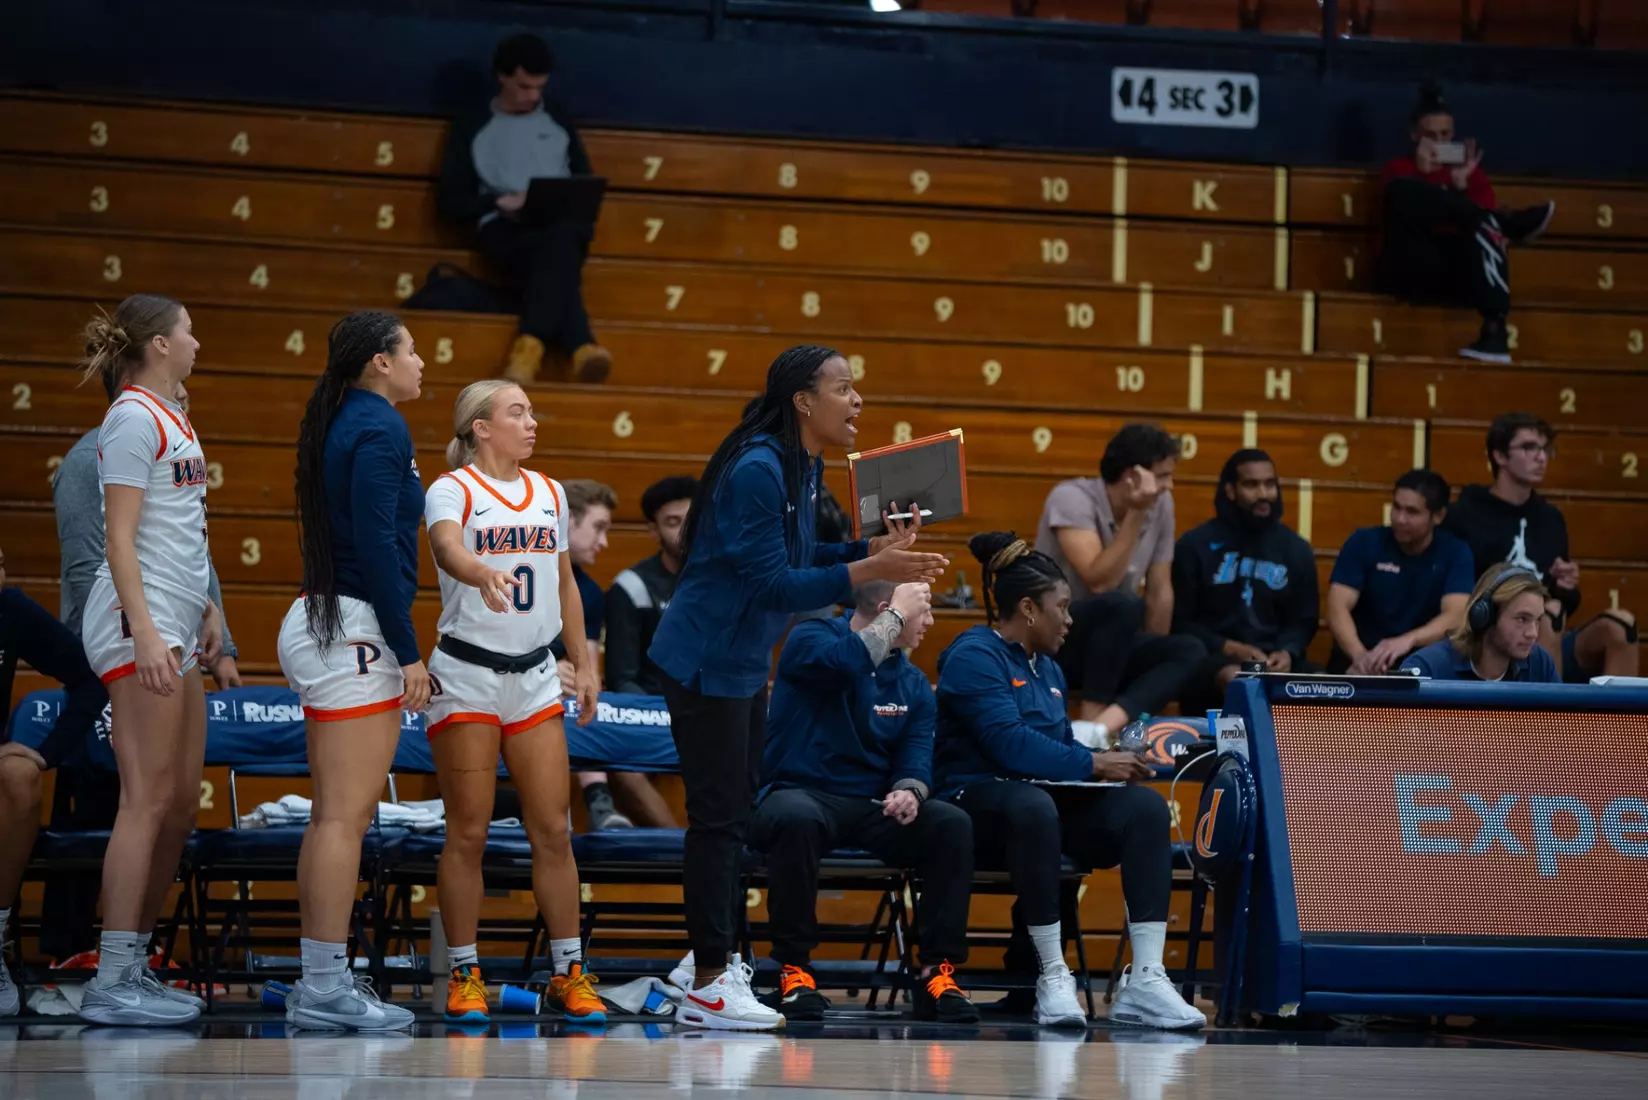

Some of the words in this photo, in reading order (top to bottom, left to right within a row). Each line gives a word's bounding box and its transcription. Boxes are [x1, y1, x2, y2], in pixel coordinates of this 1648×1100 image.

[1138, 77, 1157, 116] 4
[1169, 86, 1206, 112] SEC
[1215, 80, 1235, 118] 3
[89, 121, 108, 146] 3
[230, 132, 250, 155] 4
[375, 141, 394, 166] 5
[644, 156, 663, 180] 7
[778, 163, 798, 188] 8
[910, 170, 930, 194] 9
[1041, 177, 1069, 202] 10
[90, 187, 109, 212] 3
[231, 196, 251, 220] 4
[1192, 180, 1218, 211] K
[1342, 193, 1353, 217] 1
[377, 204, 395, 229] 5
[1597, 204, 1613, 228] 3
[645, 218, 664, 242] 7
[779, 225, 798, 250] 8
[910, 231, 930, 256] 9
[1041, 239, 1069, 264] 10
[103, 255, 122, 281] 3
[1195, 242, 1213, 272] J
[249, 265, 269, 289] 4
[396, 273, 413, 298] 5
[1598, 266, 1614, 290] 3
[666, 285, 685, 310] 7
[801, 291, 821, 317] 8
[934, 297, 954, 322] 9
[1066, 303, 1094, 329] 10
[285, 330, 305, 355] 4
[1372, 319, 1382, 343] 1
[1627, 329, 1644, 354] 3
[435, 338, 453, 363] 5
[708, 350, 727, 375] 7
[982, 359, 1002, 385] 9
[1116, 366, 1145, 392] 10
[1265, 368, 1292, 400] H
[12, 383, 31, 409] 2
[1426, 384, 1437, 408] 1
[1559, 388, 1576, 413] 2
[613, 411, 634, 438] 6
[1032, 427, 1052, 453] 9
[1320, 433, 1349, 466] G
[207, 461, 224, 489] 3
[1622, 452, 1638, 477] 2
[241, 538, 261, 565] 3
[473, 525, 558, 555] WAVES
[511, 563, 536, 614] 0
[346, 640, 381, 675] P
[1293, 683, 1312, 694] Van
[1311, 683, 1350, 696] Wagner
[31, 700, 51, 717] P
[209, 700, 227, 715] P
[201, 780, 214, 809] 2
